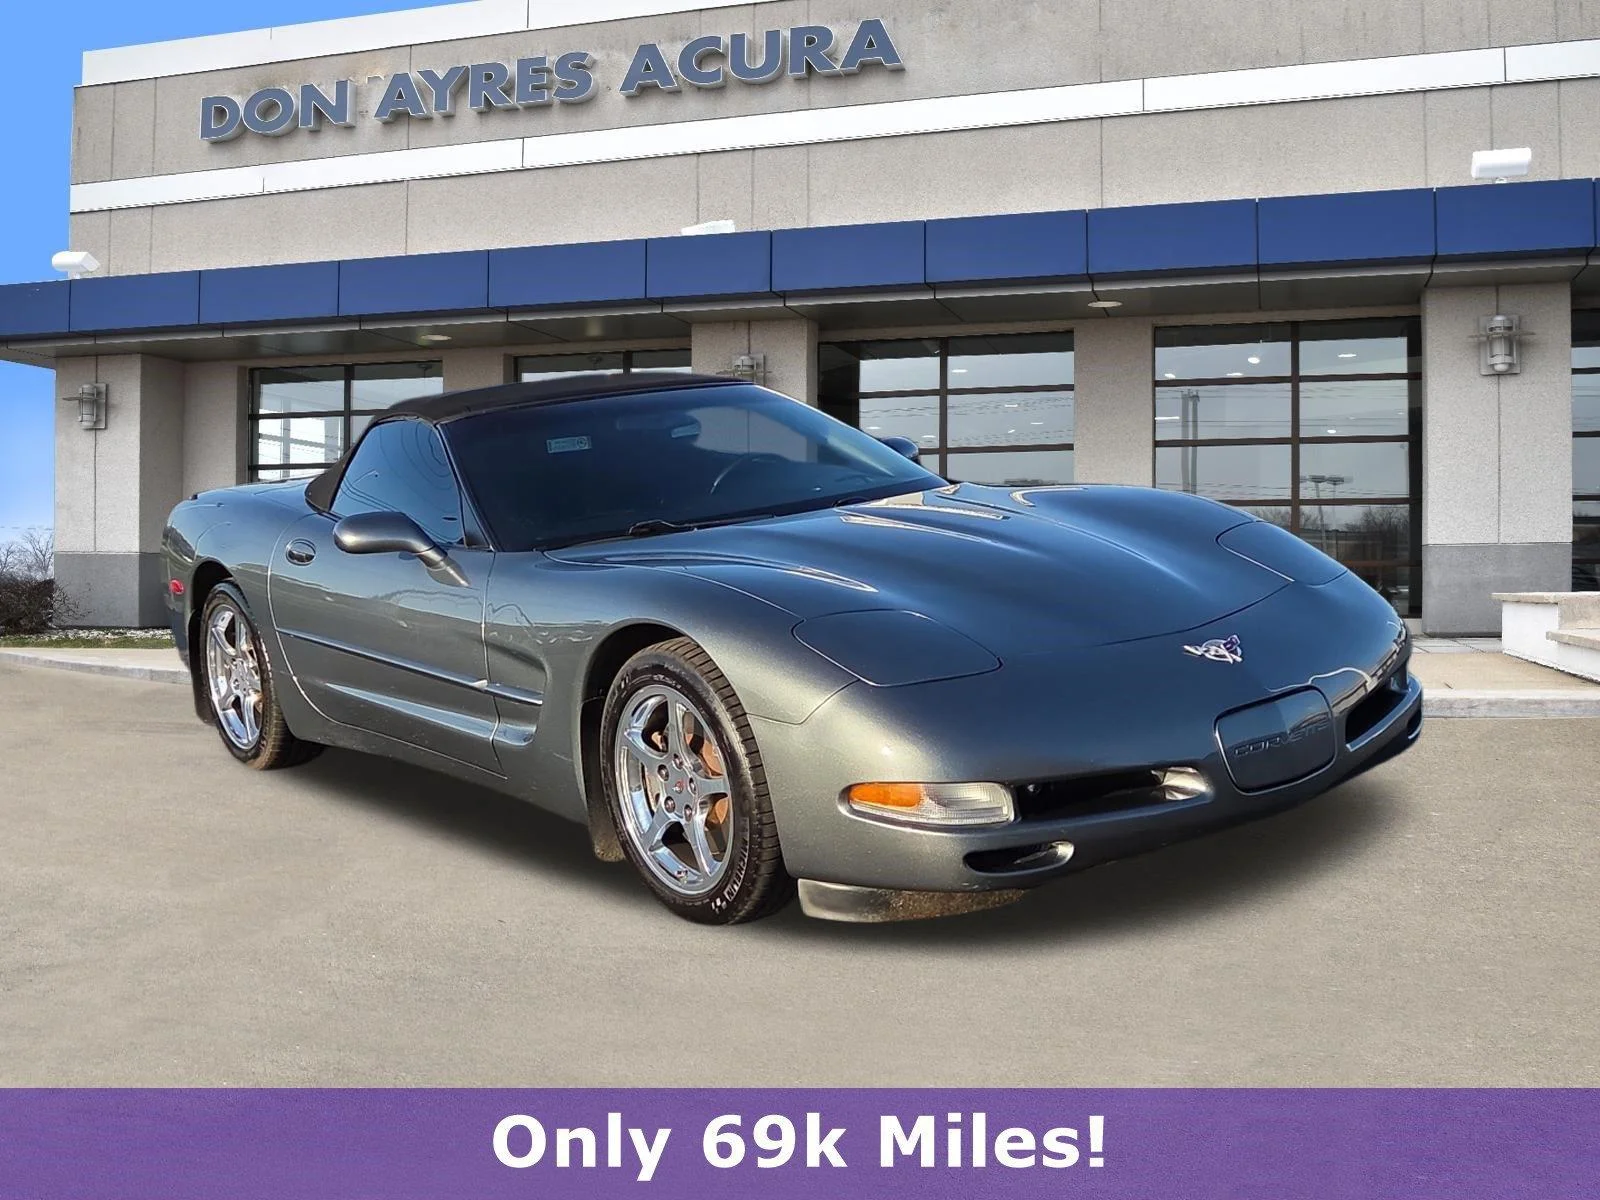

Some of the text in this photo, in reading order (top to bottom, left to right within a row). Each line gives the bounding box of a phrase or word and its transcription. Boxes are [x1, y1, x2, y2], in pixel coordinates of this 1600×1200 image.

[200, 18, 904, 142] DON AYRES ACURA
